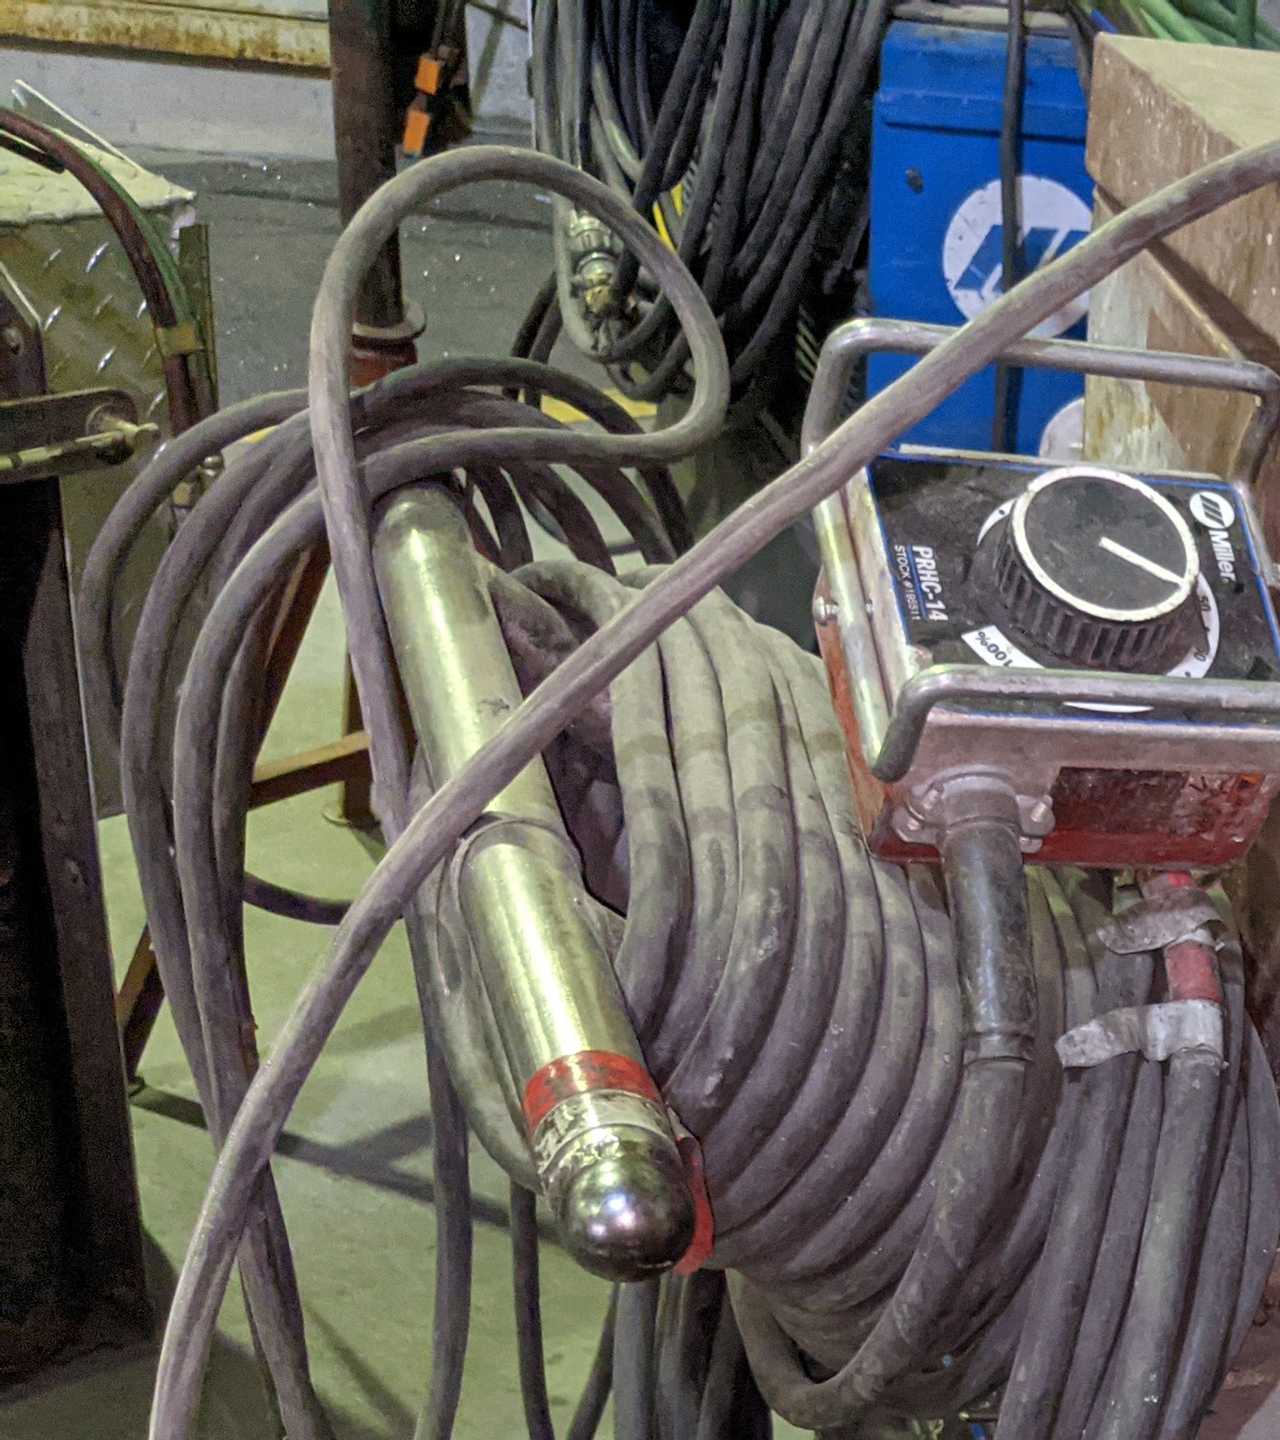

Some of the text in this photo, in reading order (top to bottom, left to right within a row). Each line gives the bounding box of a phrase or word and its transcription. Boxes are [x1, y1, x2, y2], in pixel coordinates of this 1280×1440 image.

[893, 545, 911, 578] STOCK
[1208, 528, 1236, 582] Miller
[911, 545, 948, 620] PRHC-14
